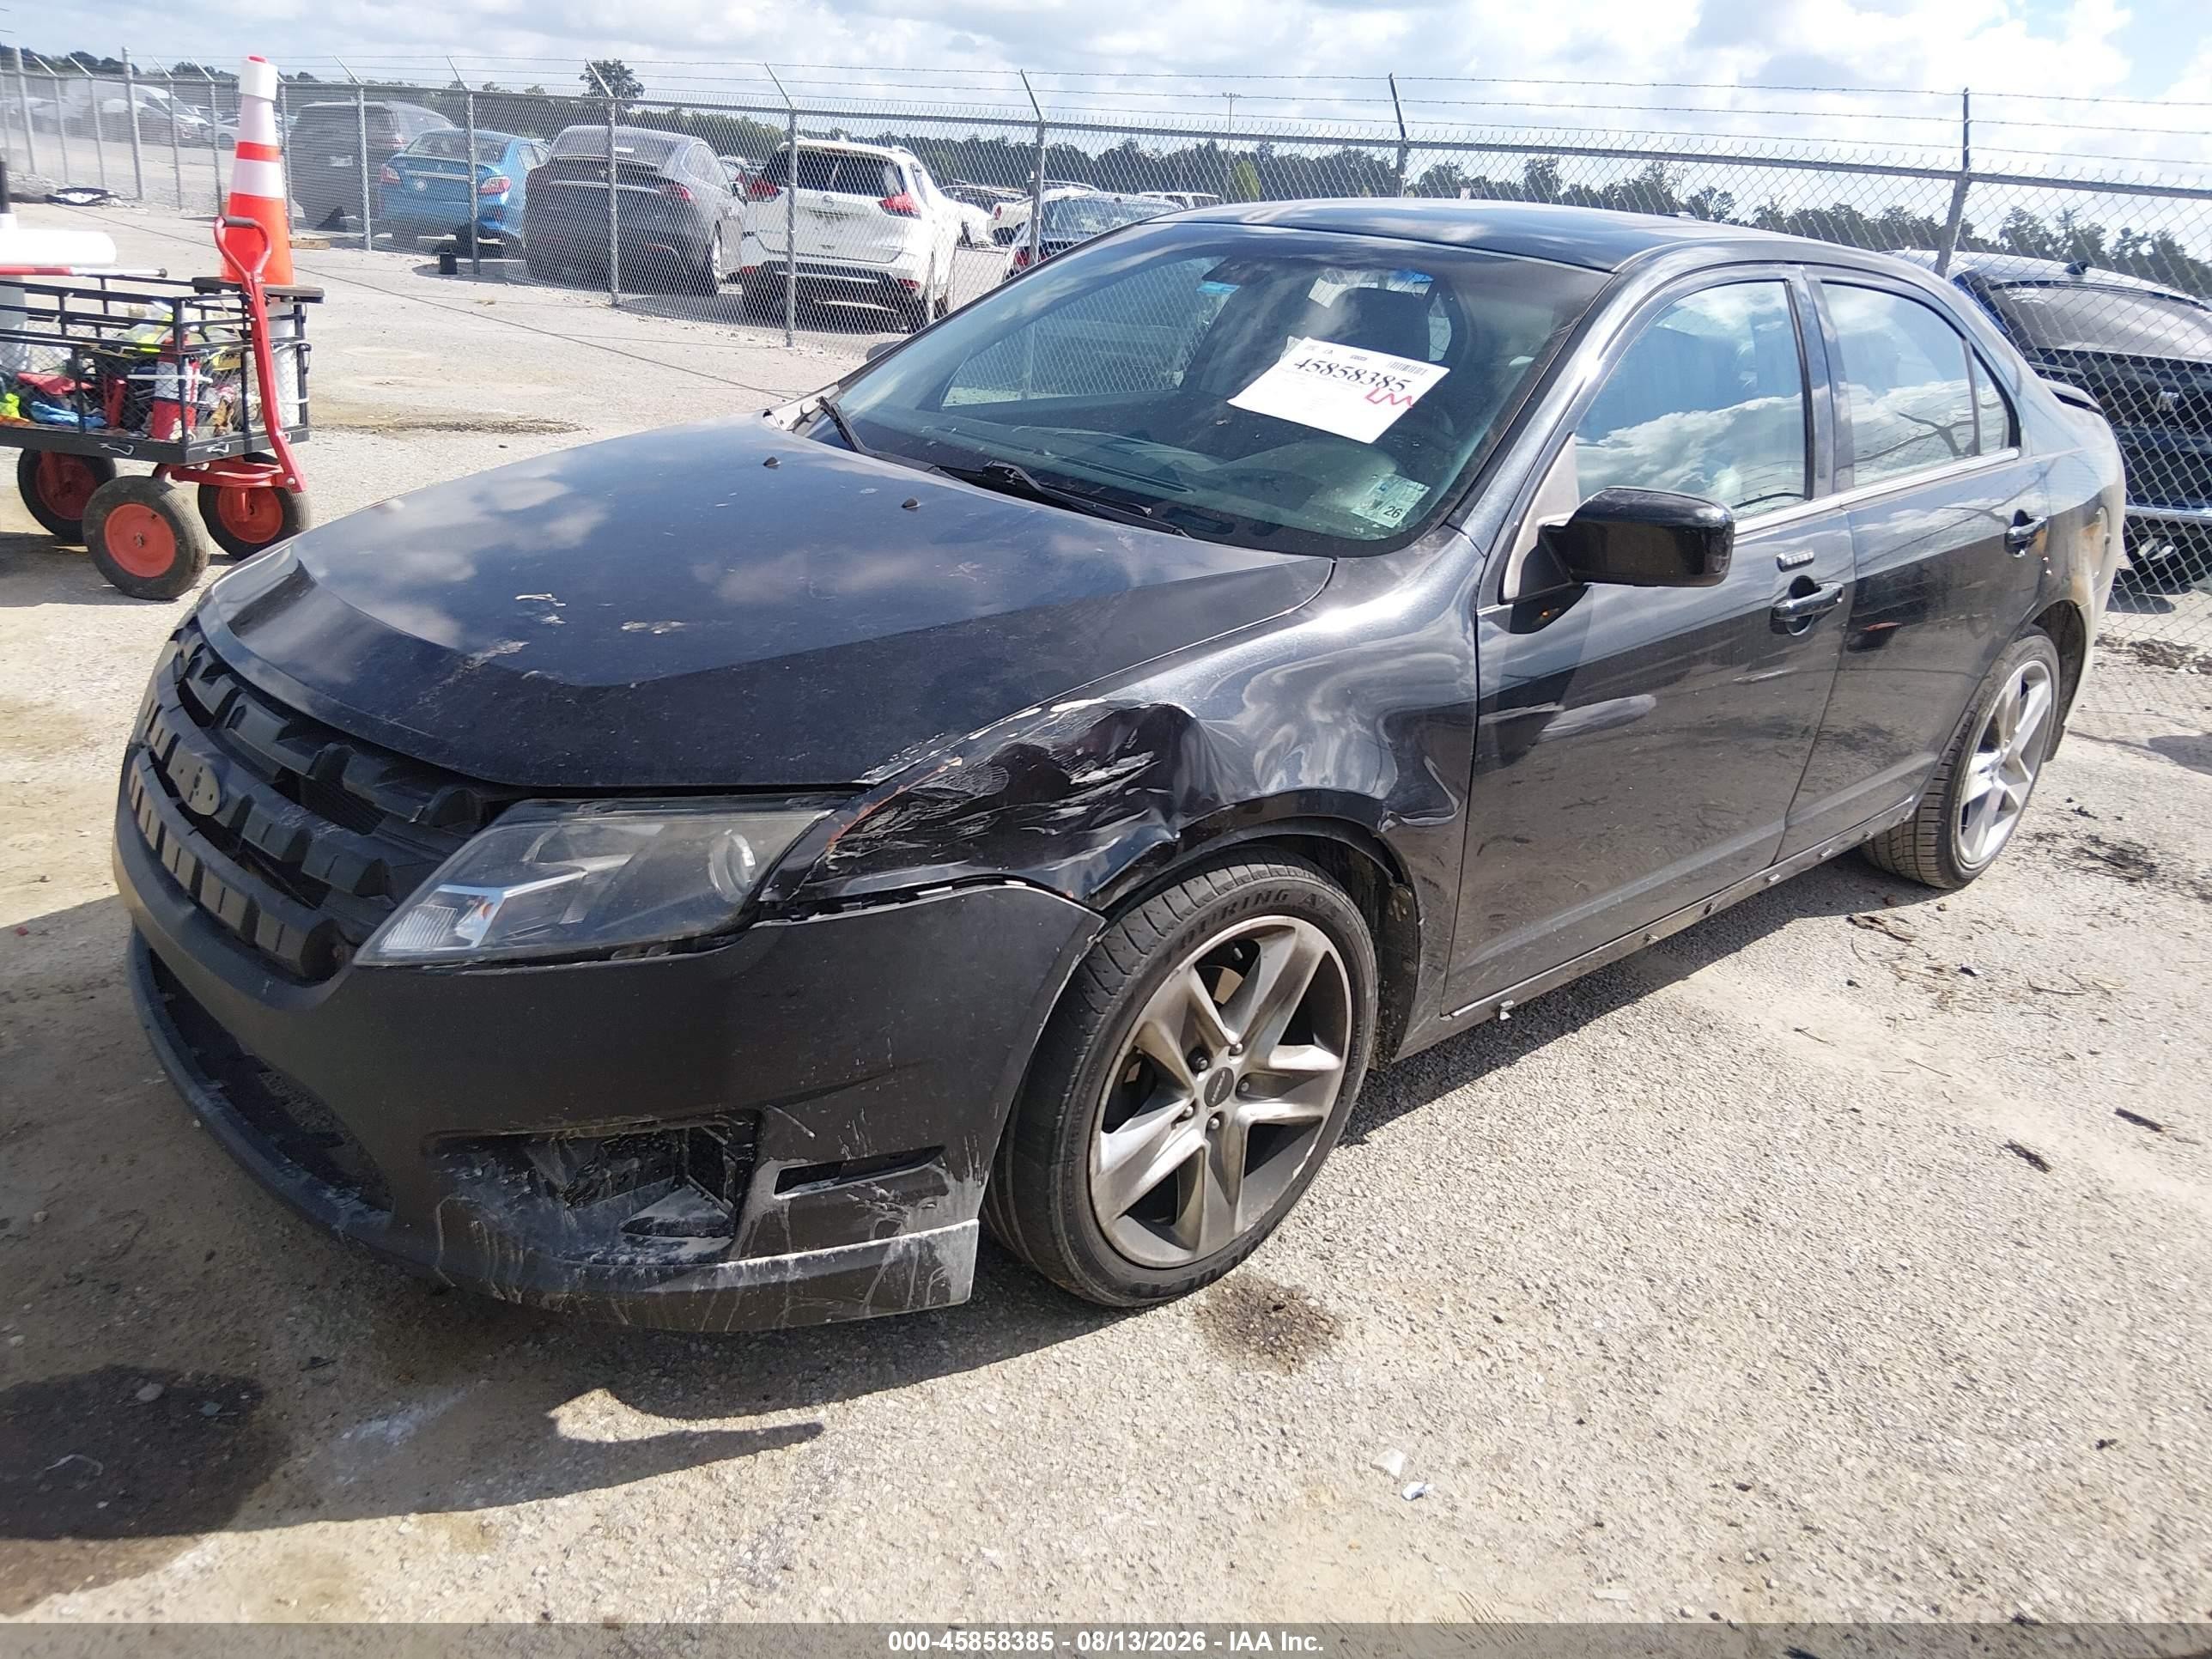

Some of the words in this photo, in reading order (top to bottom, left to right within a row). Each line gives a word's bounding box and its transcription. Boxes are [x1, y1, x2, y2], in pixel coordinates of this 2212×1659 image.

[1294, 357, 1412, 392] 45858385
[1382, 505, 1403, 519] 26
[1166, 888, 1293, 957] OURING
